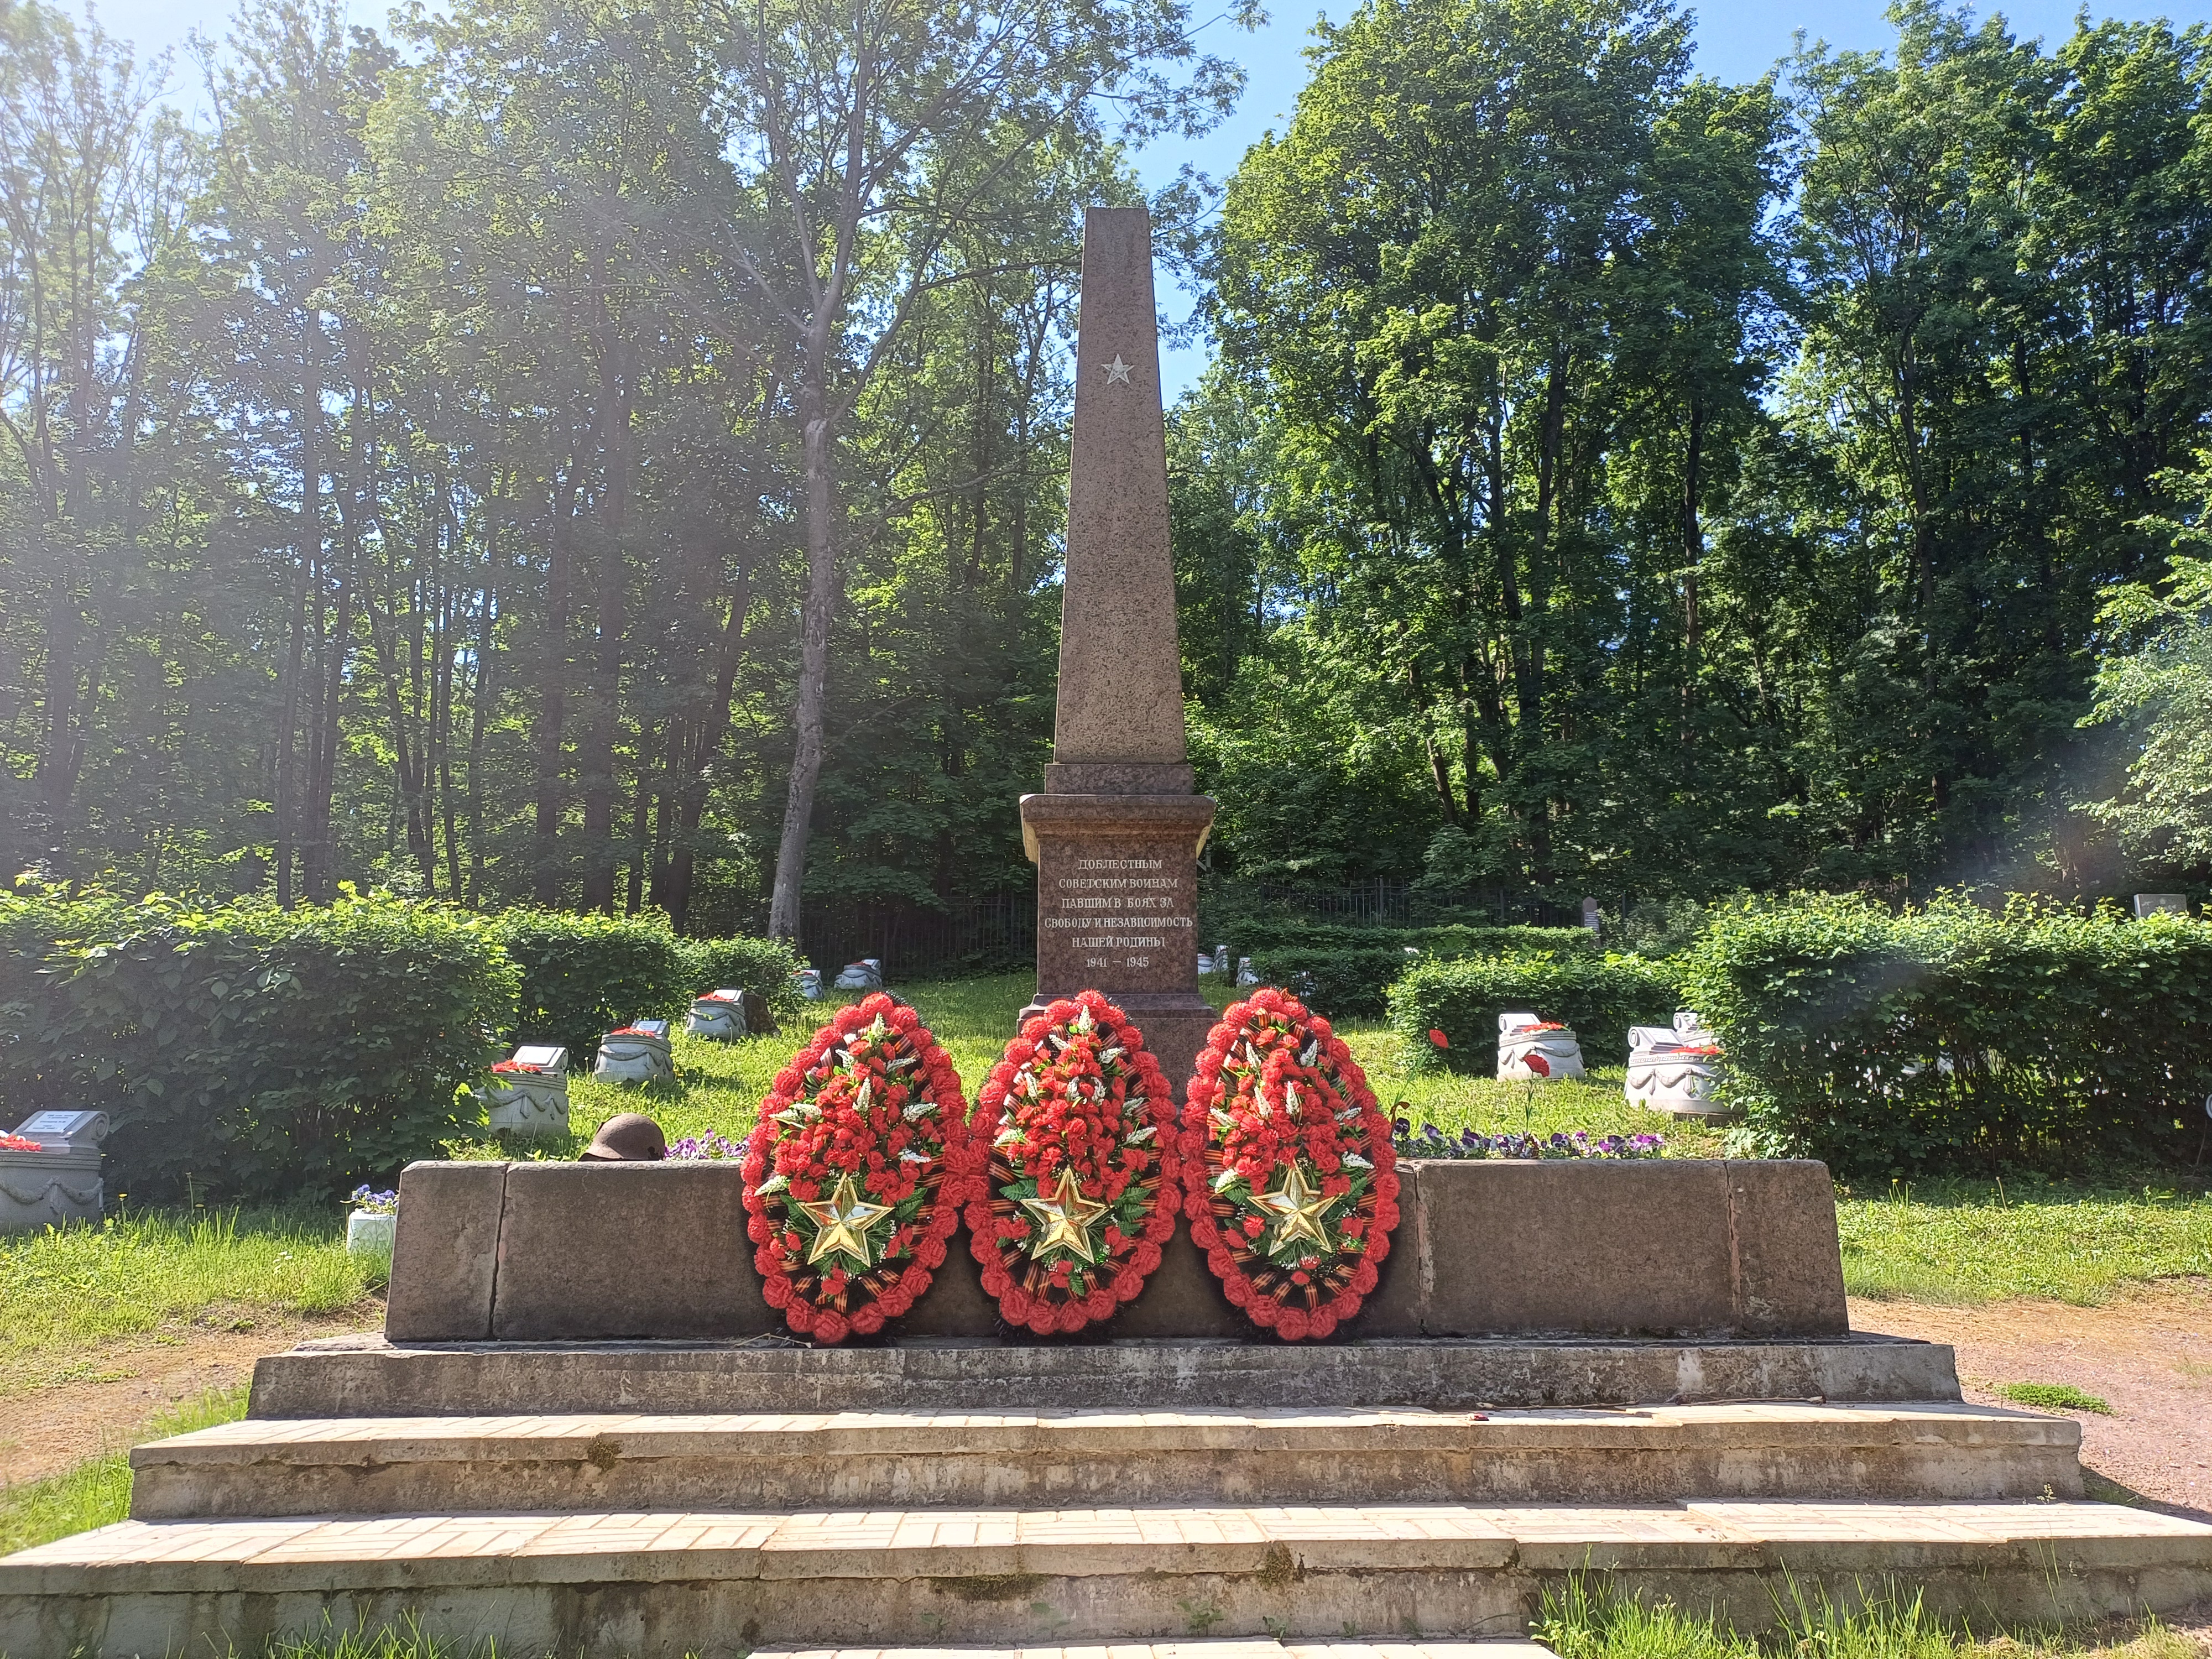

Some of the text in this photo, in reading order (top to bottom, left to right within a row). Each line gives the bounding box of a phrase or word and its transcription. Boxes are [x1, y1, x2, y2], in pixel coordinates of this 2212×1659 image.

[1078, 859, 1162, 870] ДОБЛЕСТНЫМ
[1058, 878, 1178, 889] СОВЕТСКИМ ВОИНАМ
[1061, 897, 1174, 909] ПАВШИМ В БОЯХ ЗА
[1044, 917, 1193, 929] СВОБОДУ И НЕЗАВИСИМОСТЬ
[1072, 935, 1165, 948] НАШЕЙ РОДИНЫ
[1086, 958, 1108, 968] 1941
[1126, 957, 1150, 968] 1945
